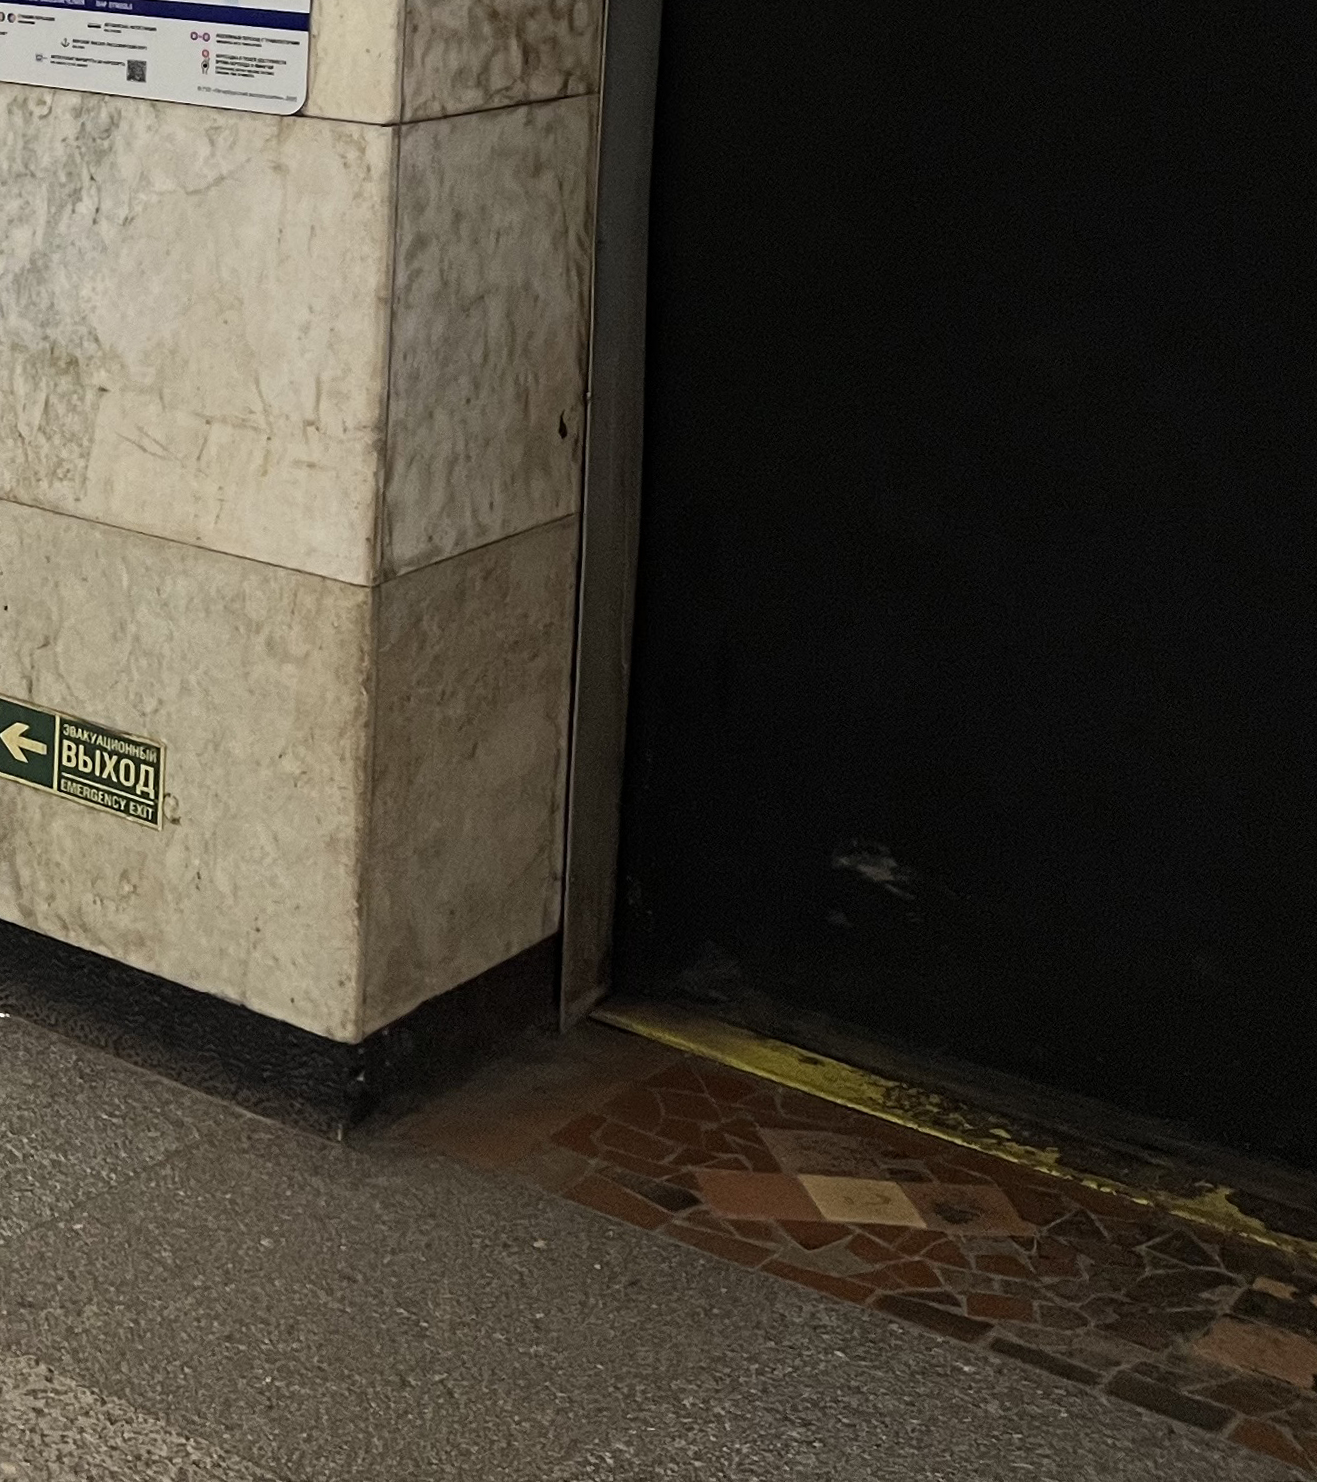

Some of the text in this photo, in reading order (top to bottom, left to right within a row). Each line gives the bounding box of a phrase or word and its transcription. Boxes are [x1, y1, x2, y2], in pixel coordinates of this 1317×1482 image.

[62, 723, 157, 763] ЭВАКУАЦИОННЫЙ
[61, 739, 156, 799] ВЫХОД
[60, 777, 156, 821] EMERGENCY EXIT
